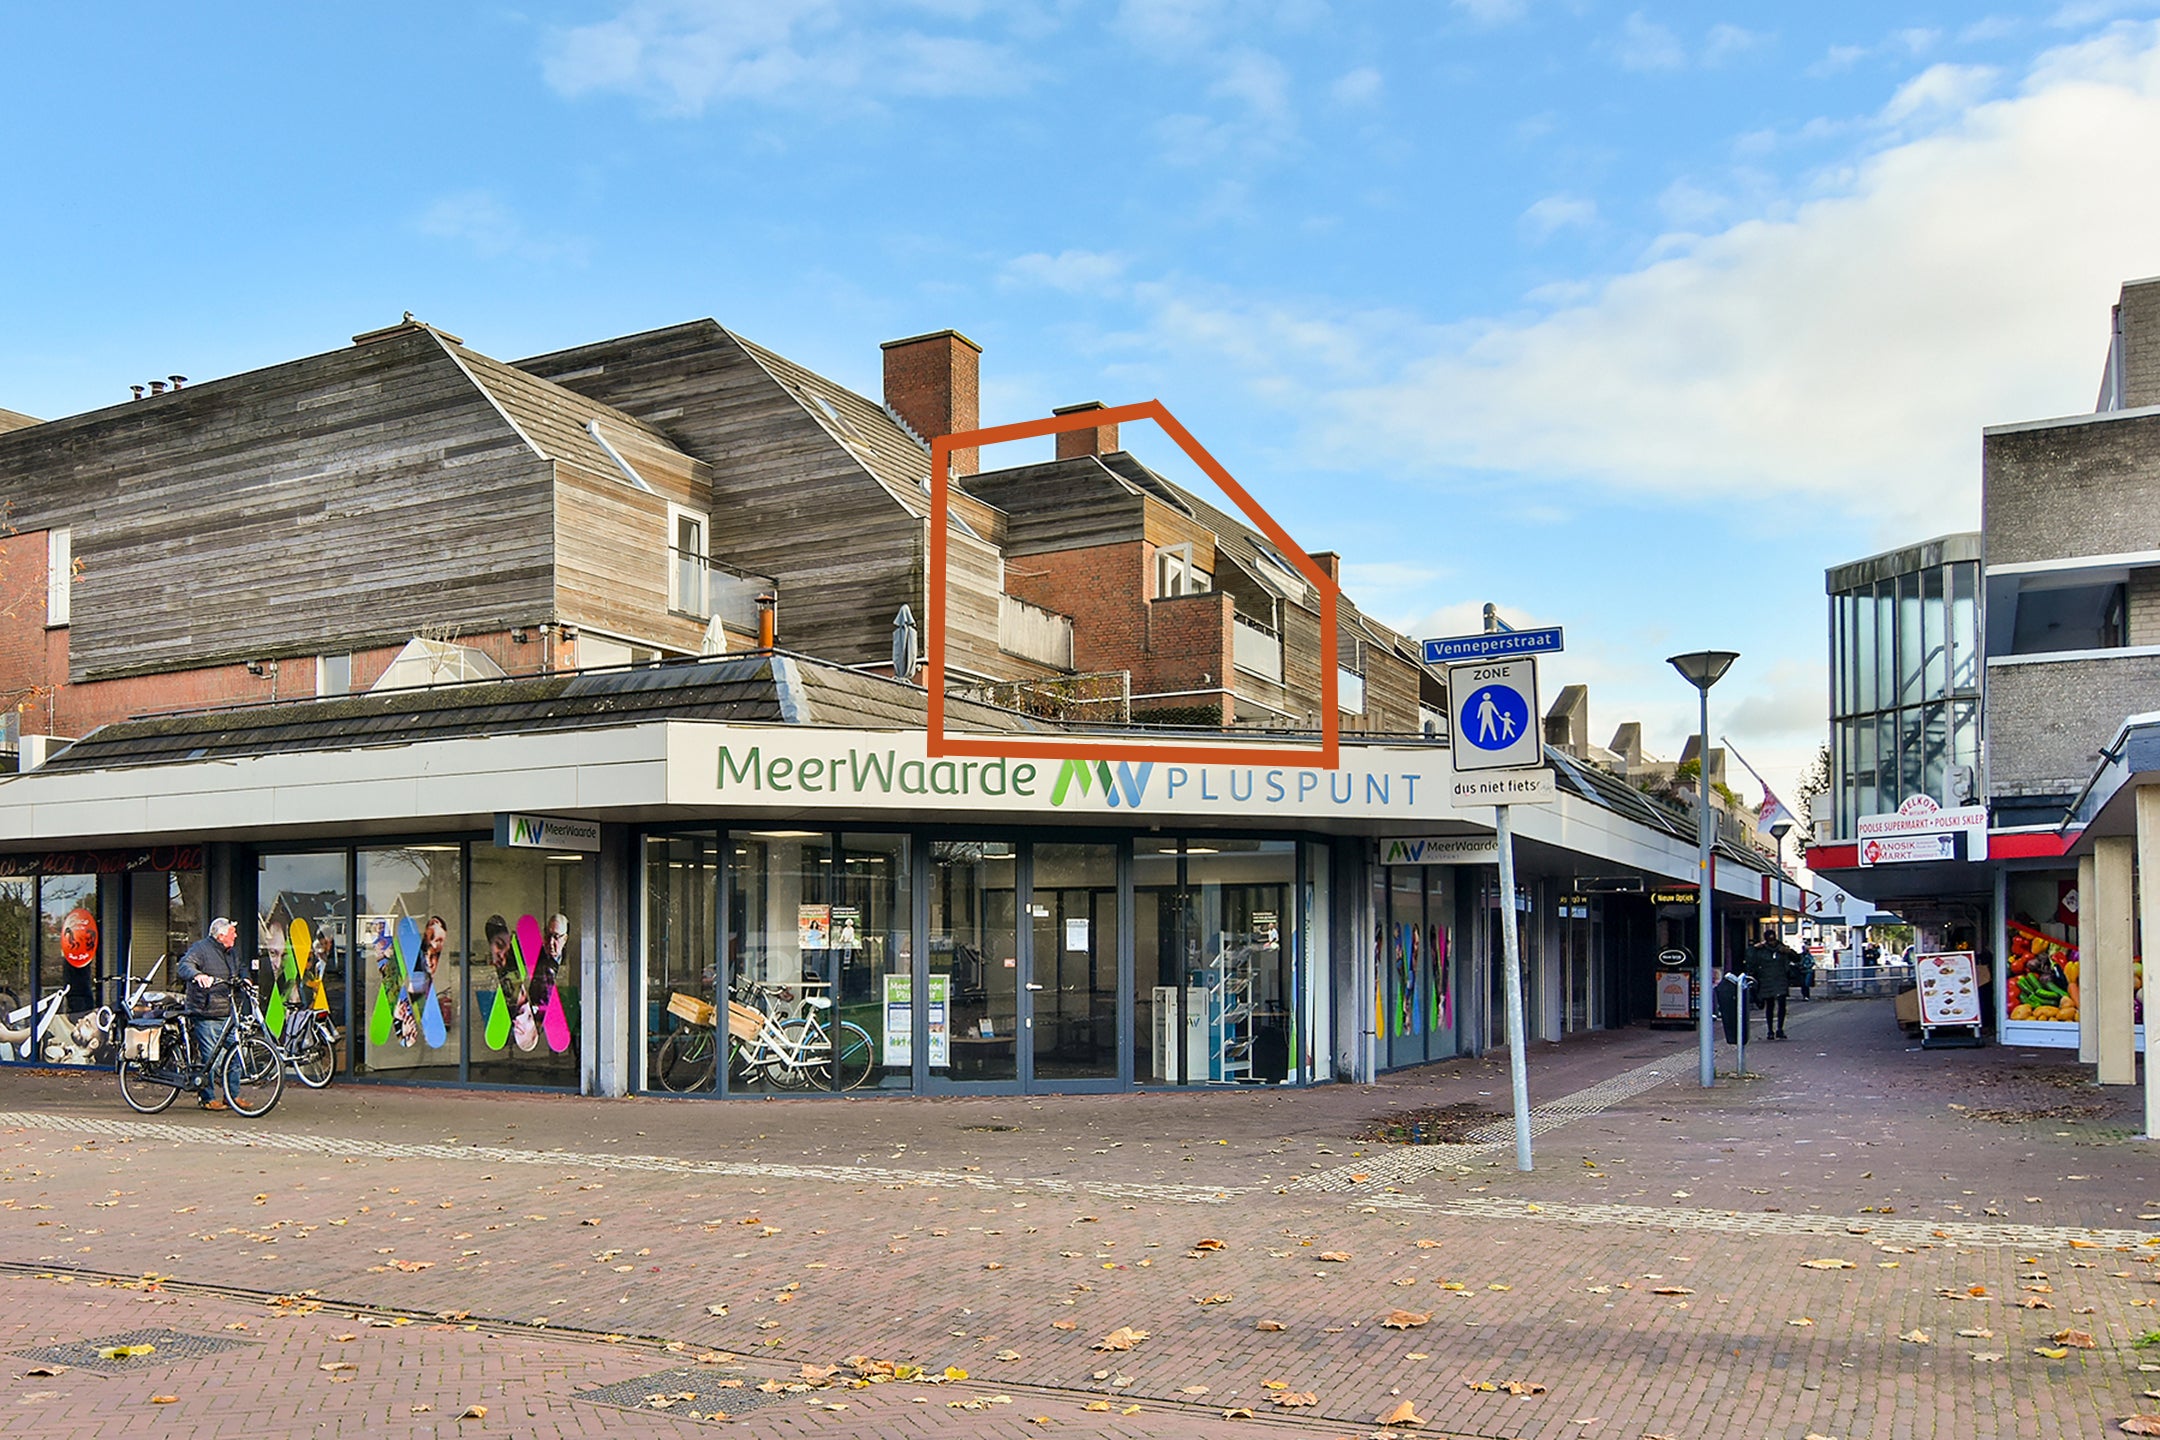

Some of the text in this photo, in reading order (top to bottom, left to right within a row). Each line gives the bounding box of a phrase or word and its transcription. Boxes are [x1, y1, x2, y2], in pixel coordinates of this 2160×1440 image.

[1434, 633, 1552, 655] Venneperstraat
[1474, 667, 1510, 681] ZONE
[717, 745, 1037, 796] MeerWaarde
[1167, 767, 1421, 805] PLUSPUNT
[1454, 783, 1476, 795] dus
[1480, 781, 1504, 793] niet
[1900, 796, 1938, 817] WELKOM
[545, 823, 597, 839] MeerWaarde
[1859, 814, 1985, 834] POOLSE SUPERMARKT POLSKI SKLEP
[1427, 840, 1498, 853] MeerWaarde
